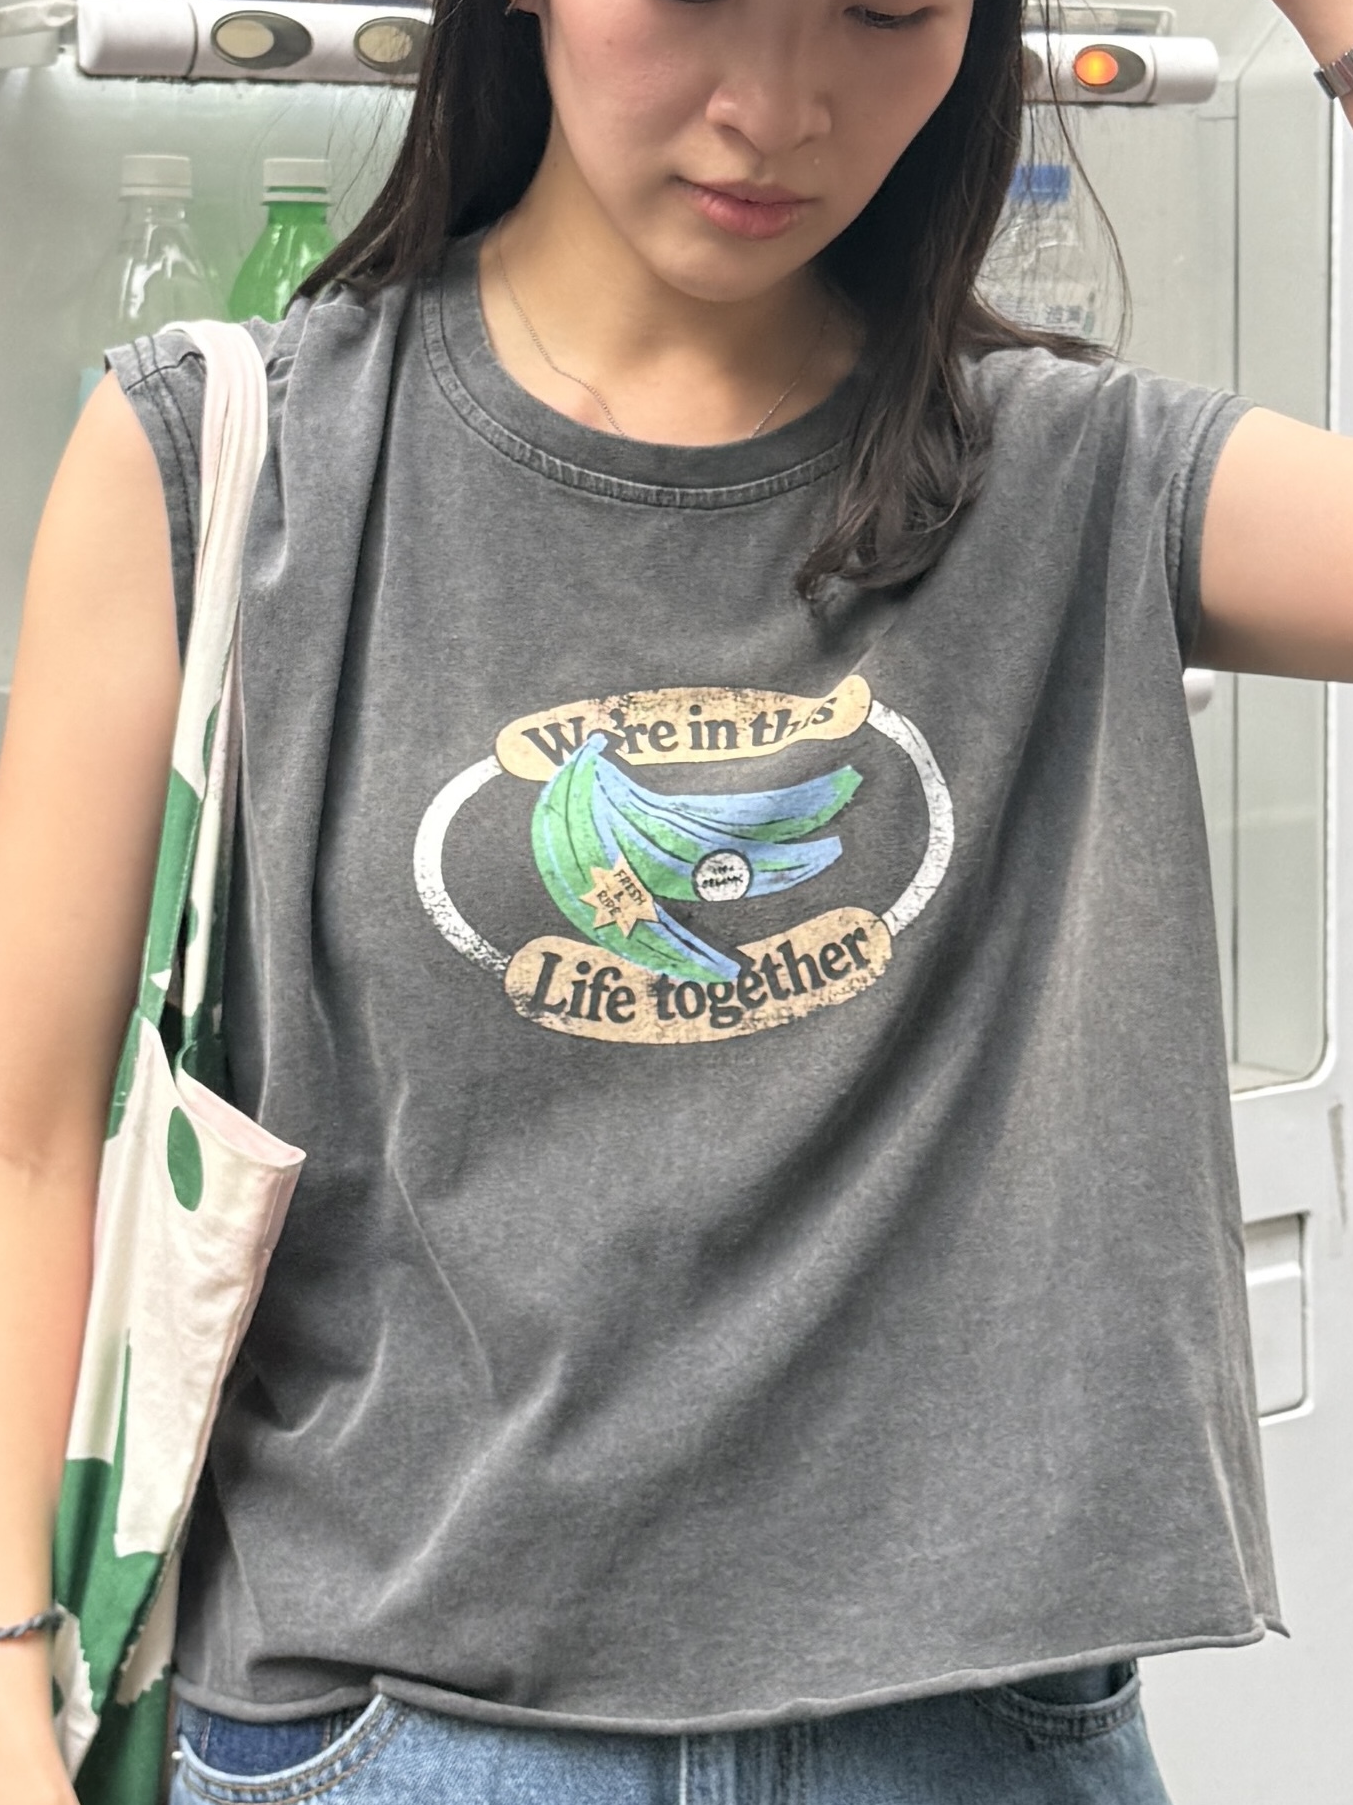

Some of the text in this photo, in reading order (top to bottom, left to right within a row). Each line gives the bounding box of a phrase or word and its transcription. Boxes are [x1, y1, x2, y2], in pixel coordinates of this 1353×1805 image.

[522, 697, 838, 767] W're in ths
[595, 889, 622, 917] RIPE
[613, 869, 647, 906] FRESH
[527, 925, 871, 1029] Life together
